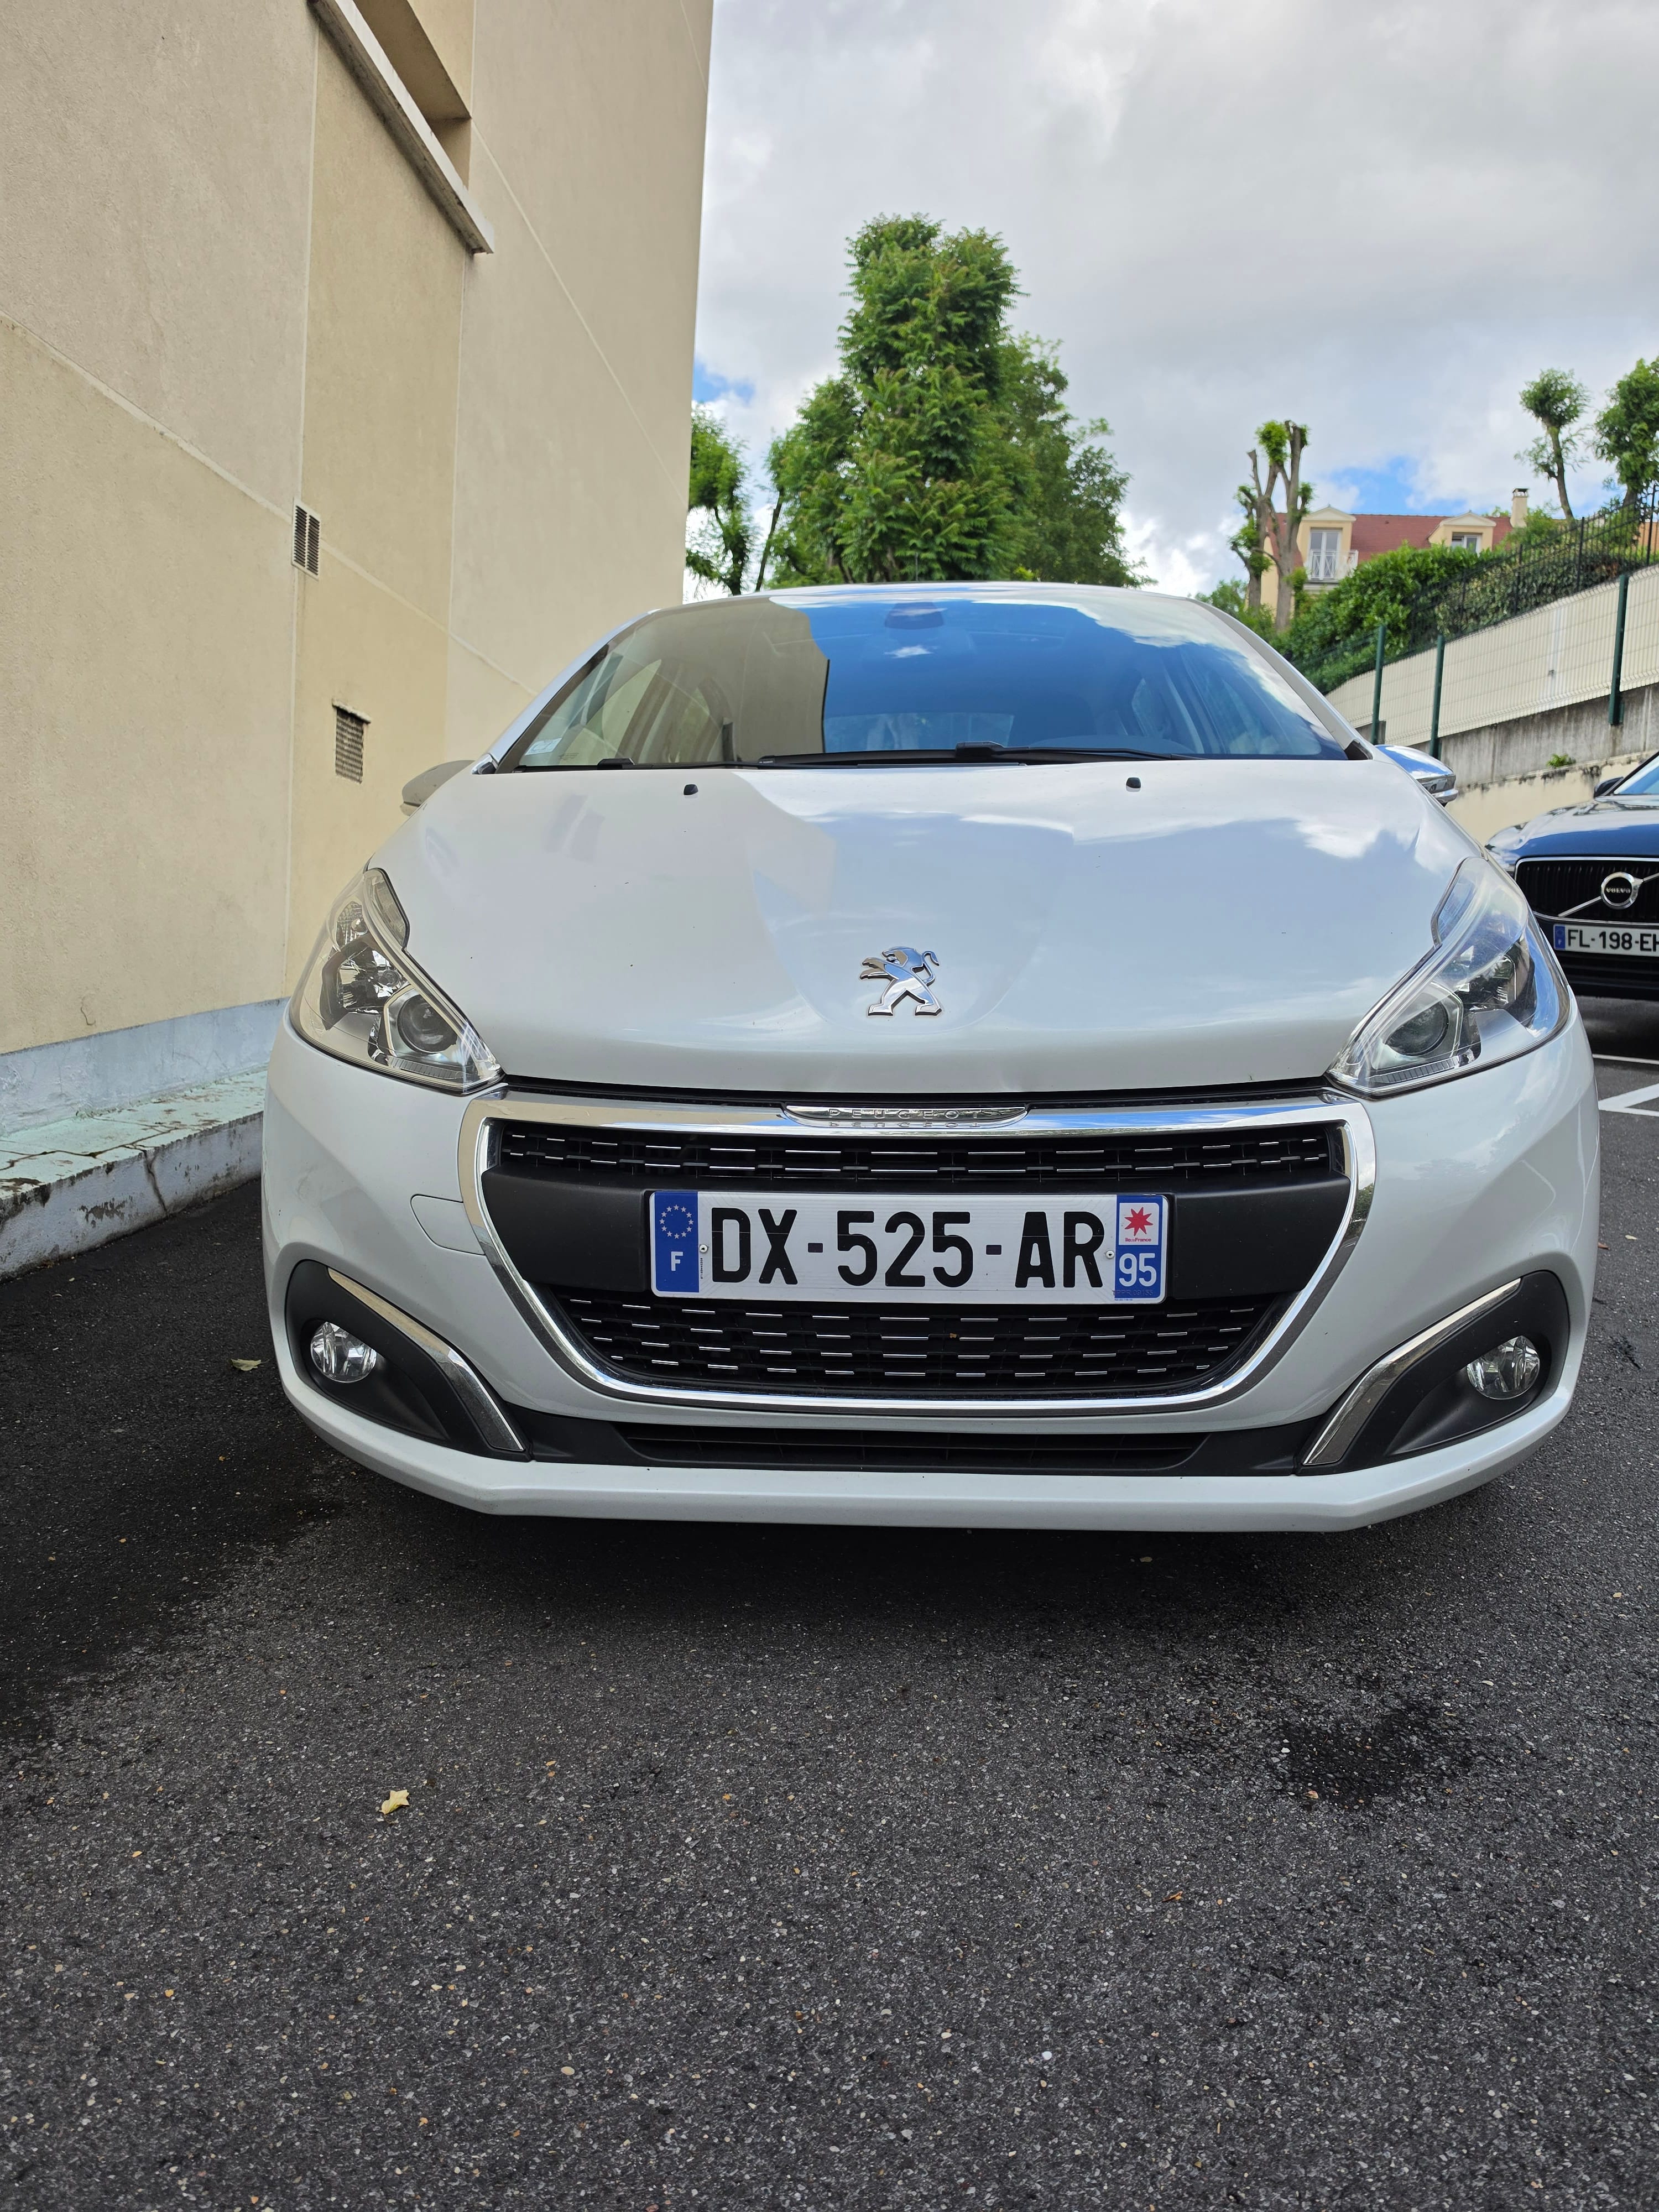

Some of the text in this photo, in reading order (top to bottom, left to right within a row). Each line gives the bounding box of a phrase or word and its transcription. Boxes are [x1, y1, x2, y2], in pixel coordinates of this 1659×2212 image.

[829, 1109, 982, 1119] PEUGEOT
[671, 1251, 684, 1271] F
[712, 1207, 1104, 1288] DX-525-AR
[1119, 1253, 1157, 1287] 95
